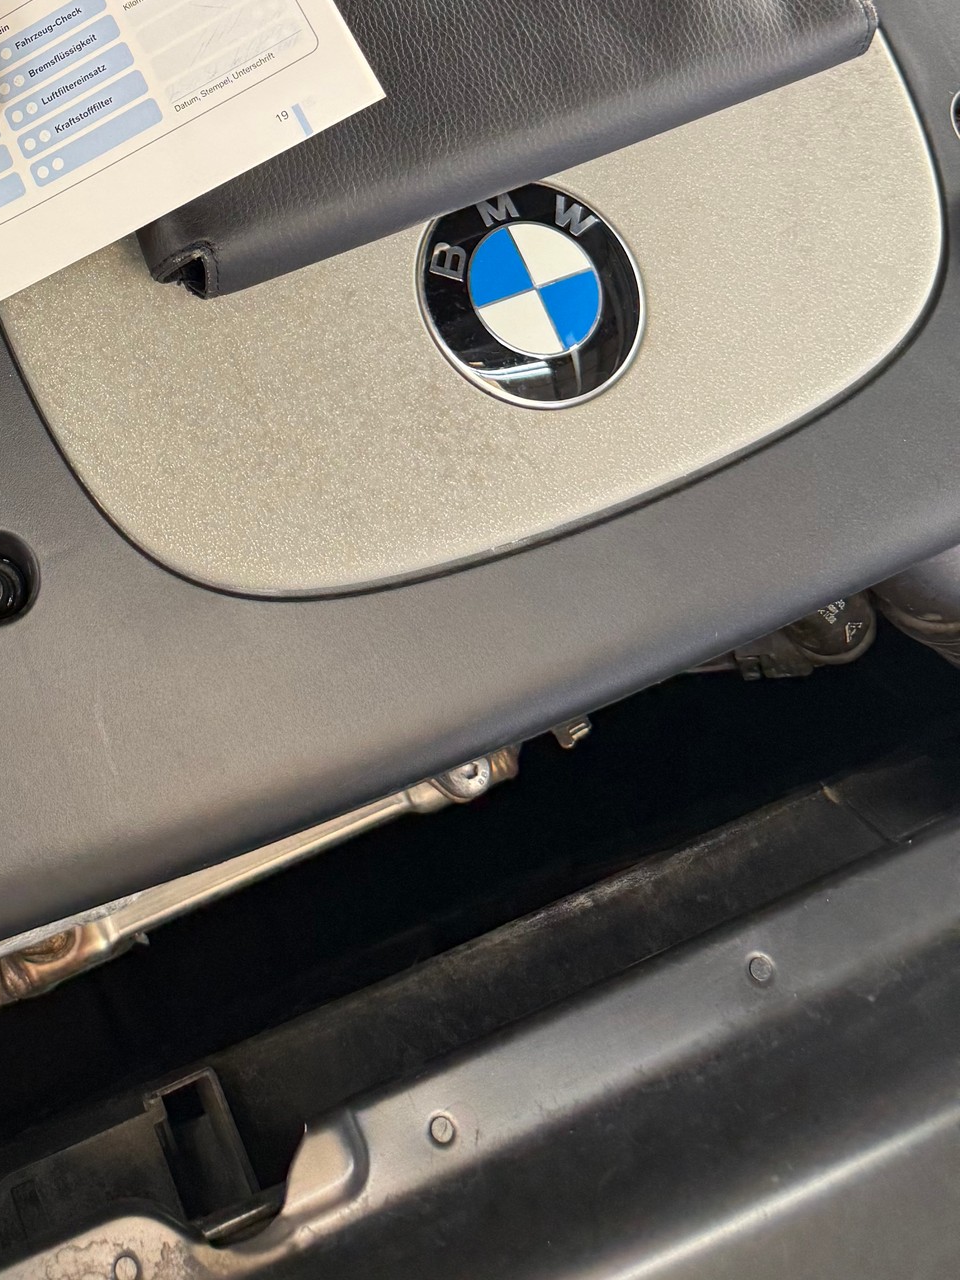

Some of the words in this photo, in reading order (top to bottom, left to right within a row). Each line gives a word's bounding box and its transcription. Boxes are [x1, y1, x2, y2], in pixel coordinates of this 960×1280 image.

[15, 7, 82, 50] Fahrzeug-Check
[29, 33, 97, 78] Bremsflüssigkeit
[41, 64, 107, 105] Luftfiltereinsatz
[174, 95, 201, 113] Datum,
[200, 77, 234, 97] Stempel,
[232, 52, 275, 80] Unterschrift
[54, 96, 113, 133] Kraftstofffilter
[275, 110, 289, 123] 19
[429, 193, 598, 282] BMW
